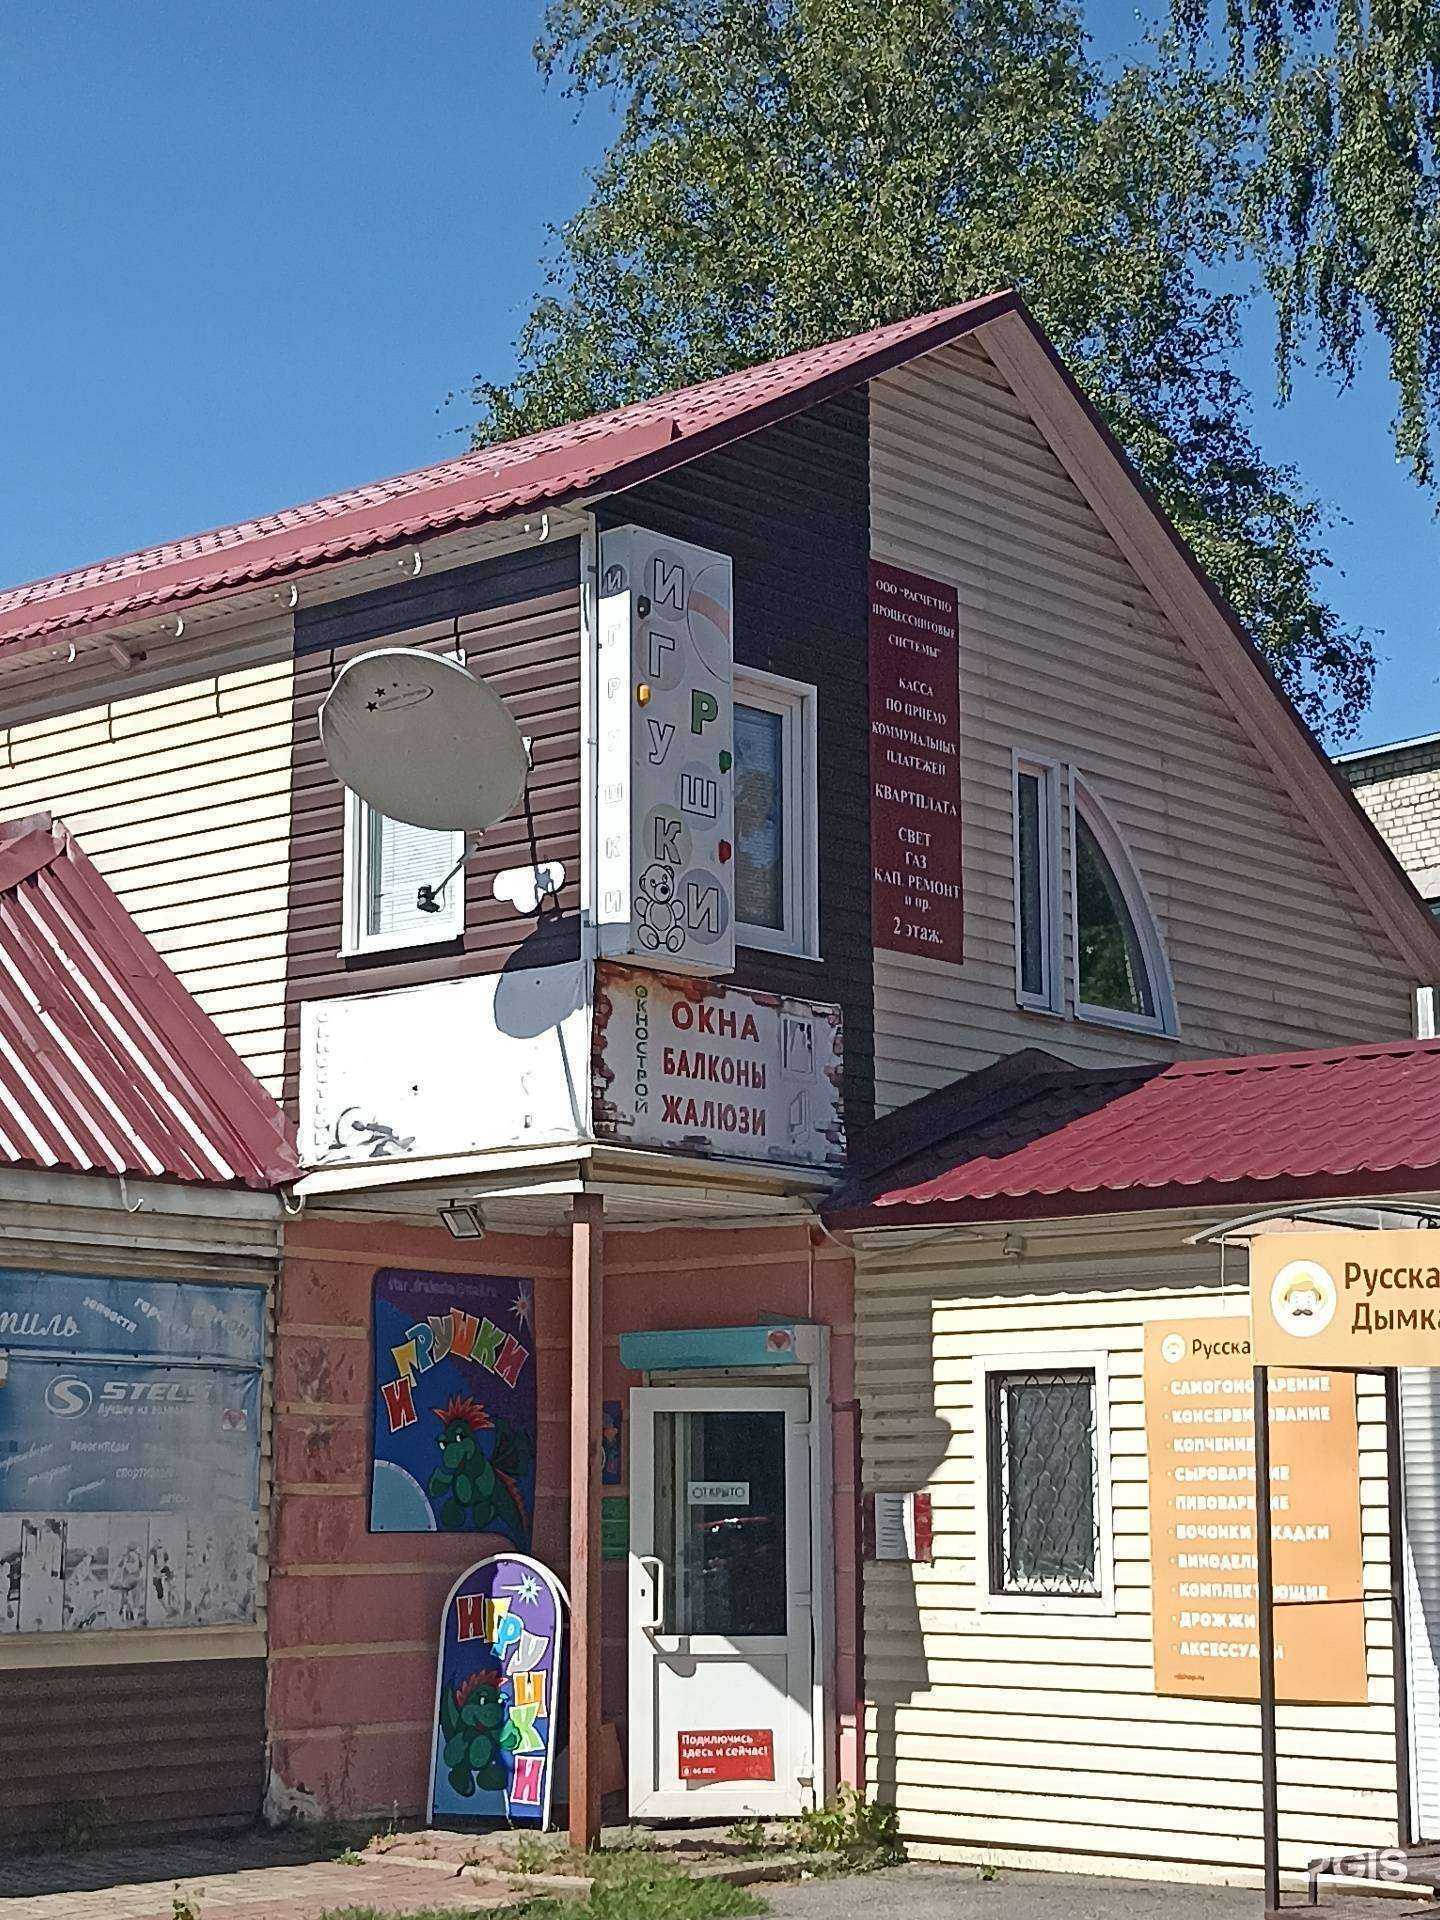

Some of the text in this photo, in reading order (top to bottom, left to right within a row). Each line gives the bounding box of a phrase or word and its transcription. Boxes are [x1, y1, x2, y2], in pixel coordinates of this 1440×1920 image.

[876, 580, 897, 594] ООО
[899, 678, 934, 697] КАССА
[886, 698, 949, 725] ПО ПРИЕМУ
[647, 557, 719, 934] ИГРУШКИ
[872, 721, 958, 755] КОММУНАЛЬНЫХ
[875, 784, 958, 816] КВАРТПЛАТА
[898, 827, 932, 847] СВЕТ
[905, 851, 927, 869] ГАЗ
[908, 875, 961, 899] РЕМОНТ
[893, 916, 944, 944] 2 этаж.
[671, 1000, 760, 1043] ОКНА
[663, 1046, 767, 1090] БАЛКОНЫ
[661, 1093, 767, 1137] ЖАЛЮЗИ
[1351, 1302, 1440, 1335] Дымк
[381, 1306, 530, 1433] ИГРУШКИ
[1170, 1375, 1330, 1395] САМОГОНОАРЕНИЕ
[1171, 1406, 1330, 1424] КОНСЕРВИОВАНИЕ
[1174, 1465, 1290, 1481] СЫРОВАРЕИЕ
[692, 1486, 746, 1499] ОТКРЫТО
[1175, 1495, 1290, 1511] ПИВОВАРЕИЕ
[1179, 1582, 1328, 1601] КОМПЛЕКТЮЩИЕ
[1180, 1611, 1255, 1628] ДРОЖЖИ
[1180, 1641, 1284, 1659] АКСЕССУАЫ
[456, 1593, 549, 1806] ИГРУШКИ
[682, 1734, 754, 1747] Подключись
[682, 1747, 714, 1758] здесь
[716, 1748, 724, 1756] и
